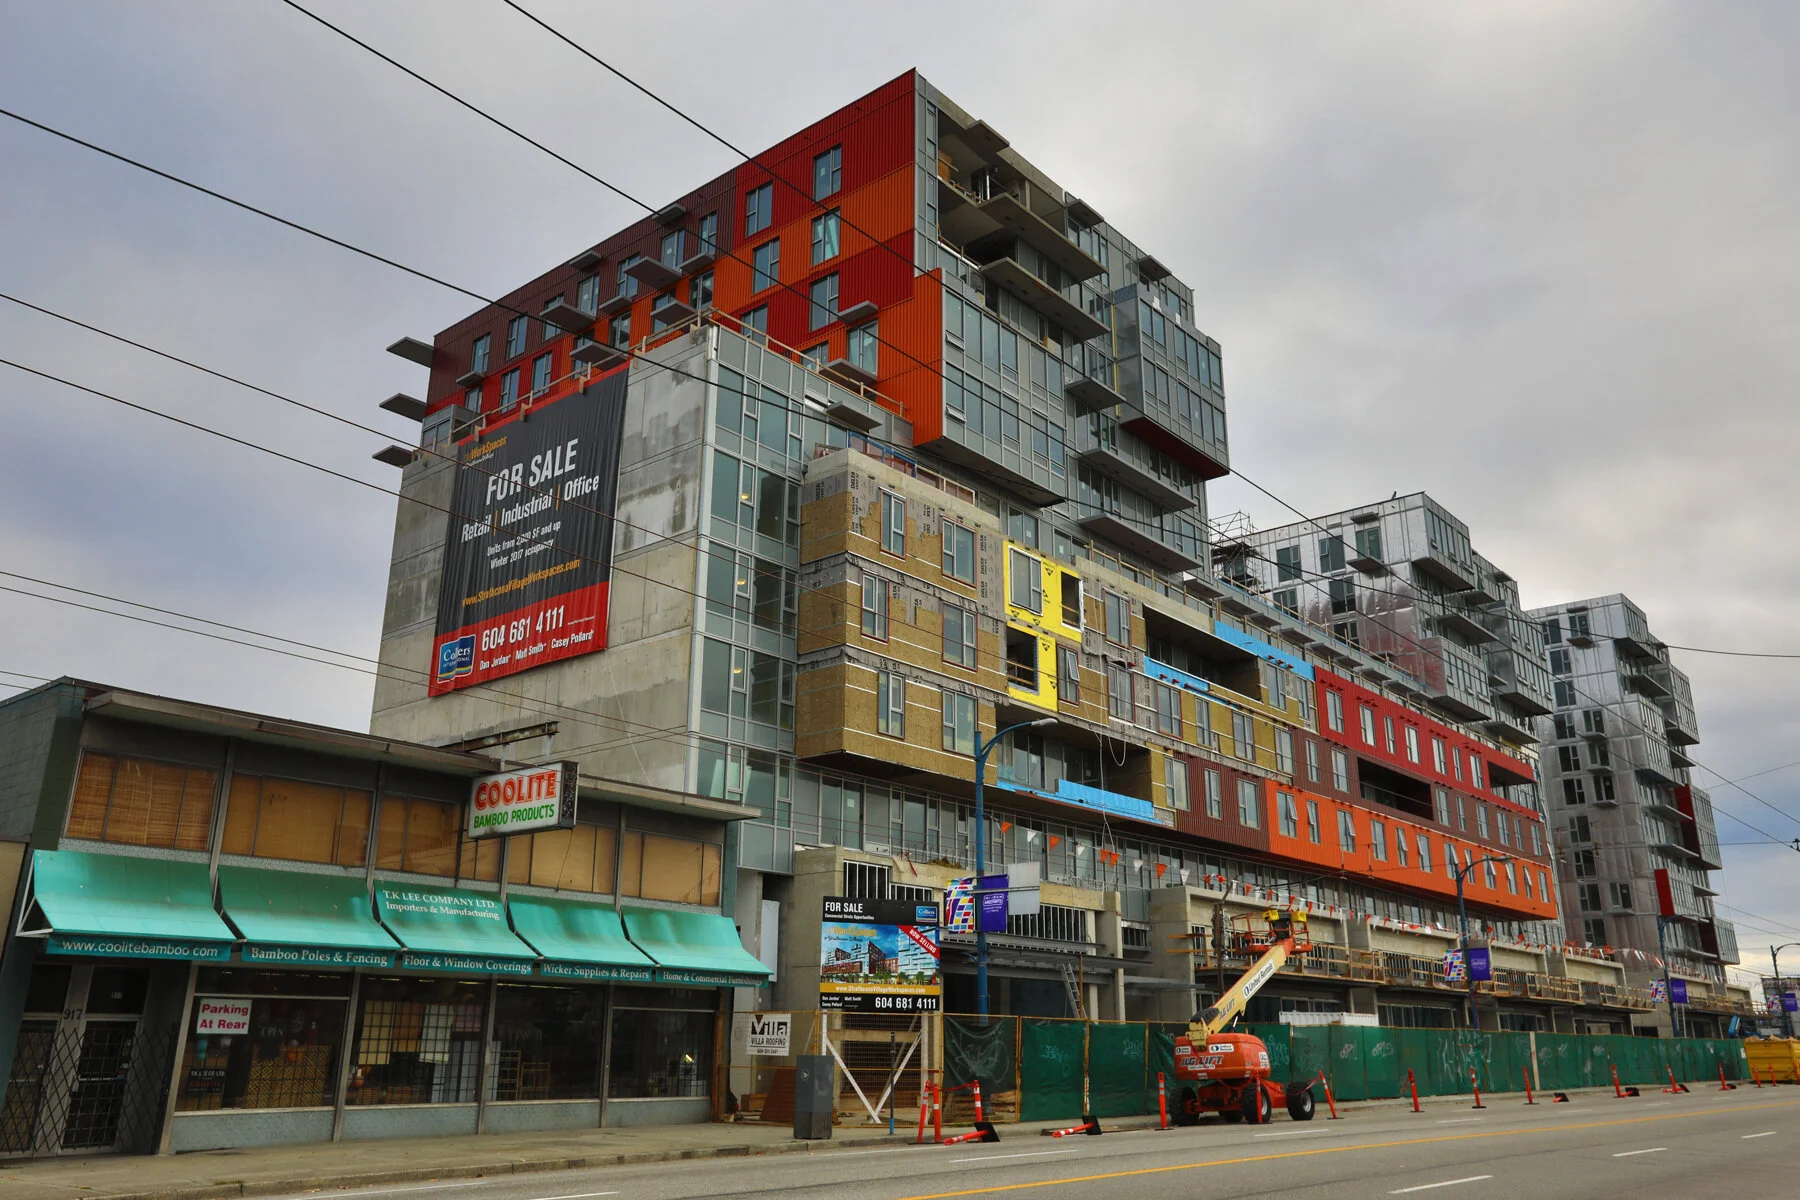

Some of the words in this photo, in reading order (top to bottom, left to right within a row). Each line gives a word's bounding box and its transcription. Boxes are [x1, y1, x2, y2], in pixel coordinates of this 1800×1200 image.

[486, 463, 523, 505] FOR
[528, 438, 578, 487] SALE
[461, 514, 492, 543] Retail
[501, 488, 553, 527] Industrial
[564, 475, 599, 501] Office
[487, 543, 501, 556] Units
[502, 540, 516, 551] from
[532, 527, 540, 538] SF
[540, 523, 552, 535] and
[552, 521, 561, 532] up
[490, 555, 509, 569] Winter
[510, 548, 523, 562] 2017
[481, 625, 505, 651] 604
[508, 616, 531, 644] 681
[536, 605, 565, 633] 4111
[443, 646, 471, 662] Coers
[480, 660, 490, 671] Dan
[515, 649, 528, 660] Matt
[551, 637, 569, 649] Casey
[475, 770, 557, 811] COOLITE
[474, 811, 508, 829] BAMBOO
[510, 804, 555, 824] PRODUCTS
[402, 892, 421, 902] LEE
[422, 895, 474, 907] COMPANY
[475, 899, 498, 909] LTD.
[825, 901, 842, 912] FOR
[843, 903, 863, 914] SALE
[386, 901, 428, 913] Importers
[430, 906, 438, 914] &
[440, 906, 500, 920] Manufacturing
[62, 941, 218, 957] www.coolitebamboocom
[909, 928, 920, 939] NOW
[919, 936, 937, 953] SELLING
[251, 947, 298, 960] Bamboo
[301, 950, 331, 962] Poles
[333, 952, 344, 963] &
[346, 952, 388, 967] Fencing
[404, 955, 430, 967] Floor
[432, 956, 441, 967] &
[443, 957, 484, 969] Window
[486, 960, 531, 975] Coverings
[543, 963, 573, 975] Wicker
[574, 966, 610, 979] Supplies
[610, 968, 618, 977] &
[619, 969, 650, 981] Repairs
[663, 971, 683, 981] Home
[683, 973, 690, 981] &
[691, 973, 728, 985] Commercial
[1248, 975, 1261, 992] United
[1260, 963, 1274, 980] Rentals
[201, 1004, 249, 1017] Parking
[875, 997, 893, 1009] 604
[896, 997, 913, 1009] 681
[916, 998, 936, 1009] 4111
[1226, 997, 1235, 1011] LIFT
[63, 1008, 83, 1020] 917
[199, 1019, 213, 1029] At
[217, 1019, 247, 1030] Rear
[751, 1014, 788, 1036] Villa
[751, 1037, 764, 1046] VILLA
[765, 1038, 786, 1046] ROOFING
[1198, 1056, 1223, 1065] LIFT
